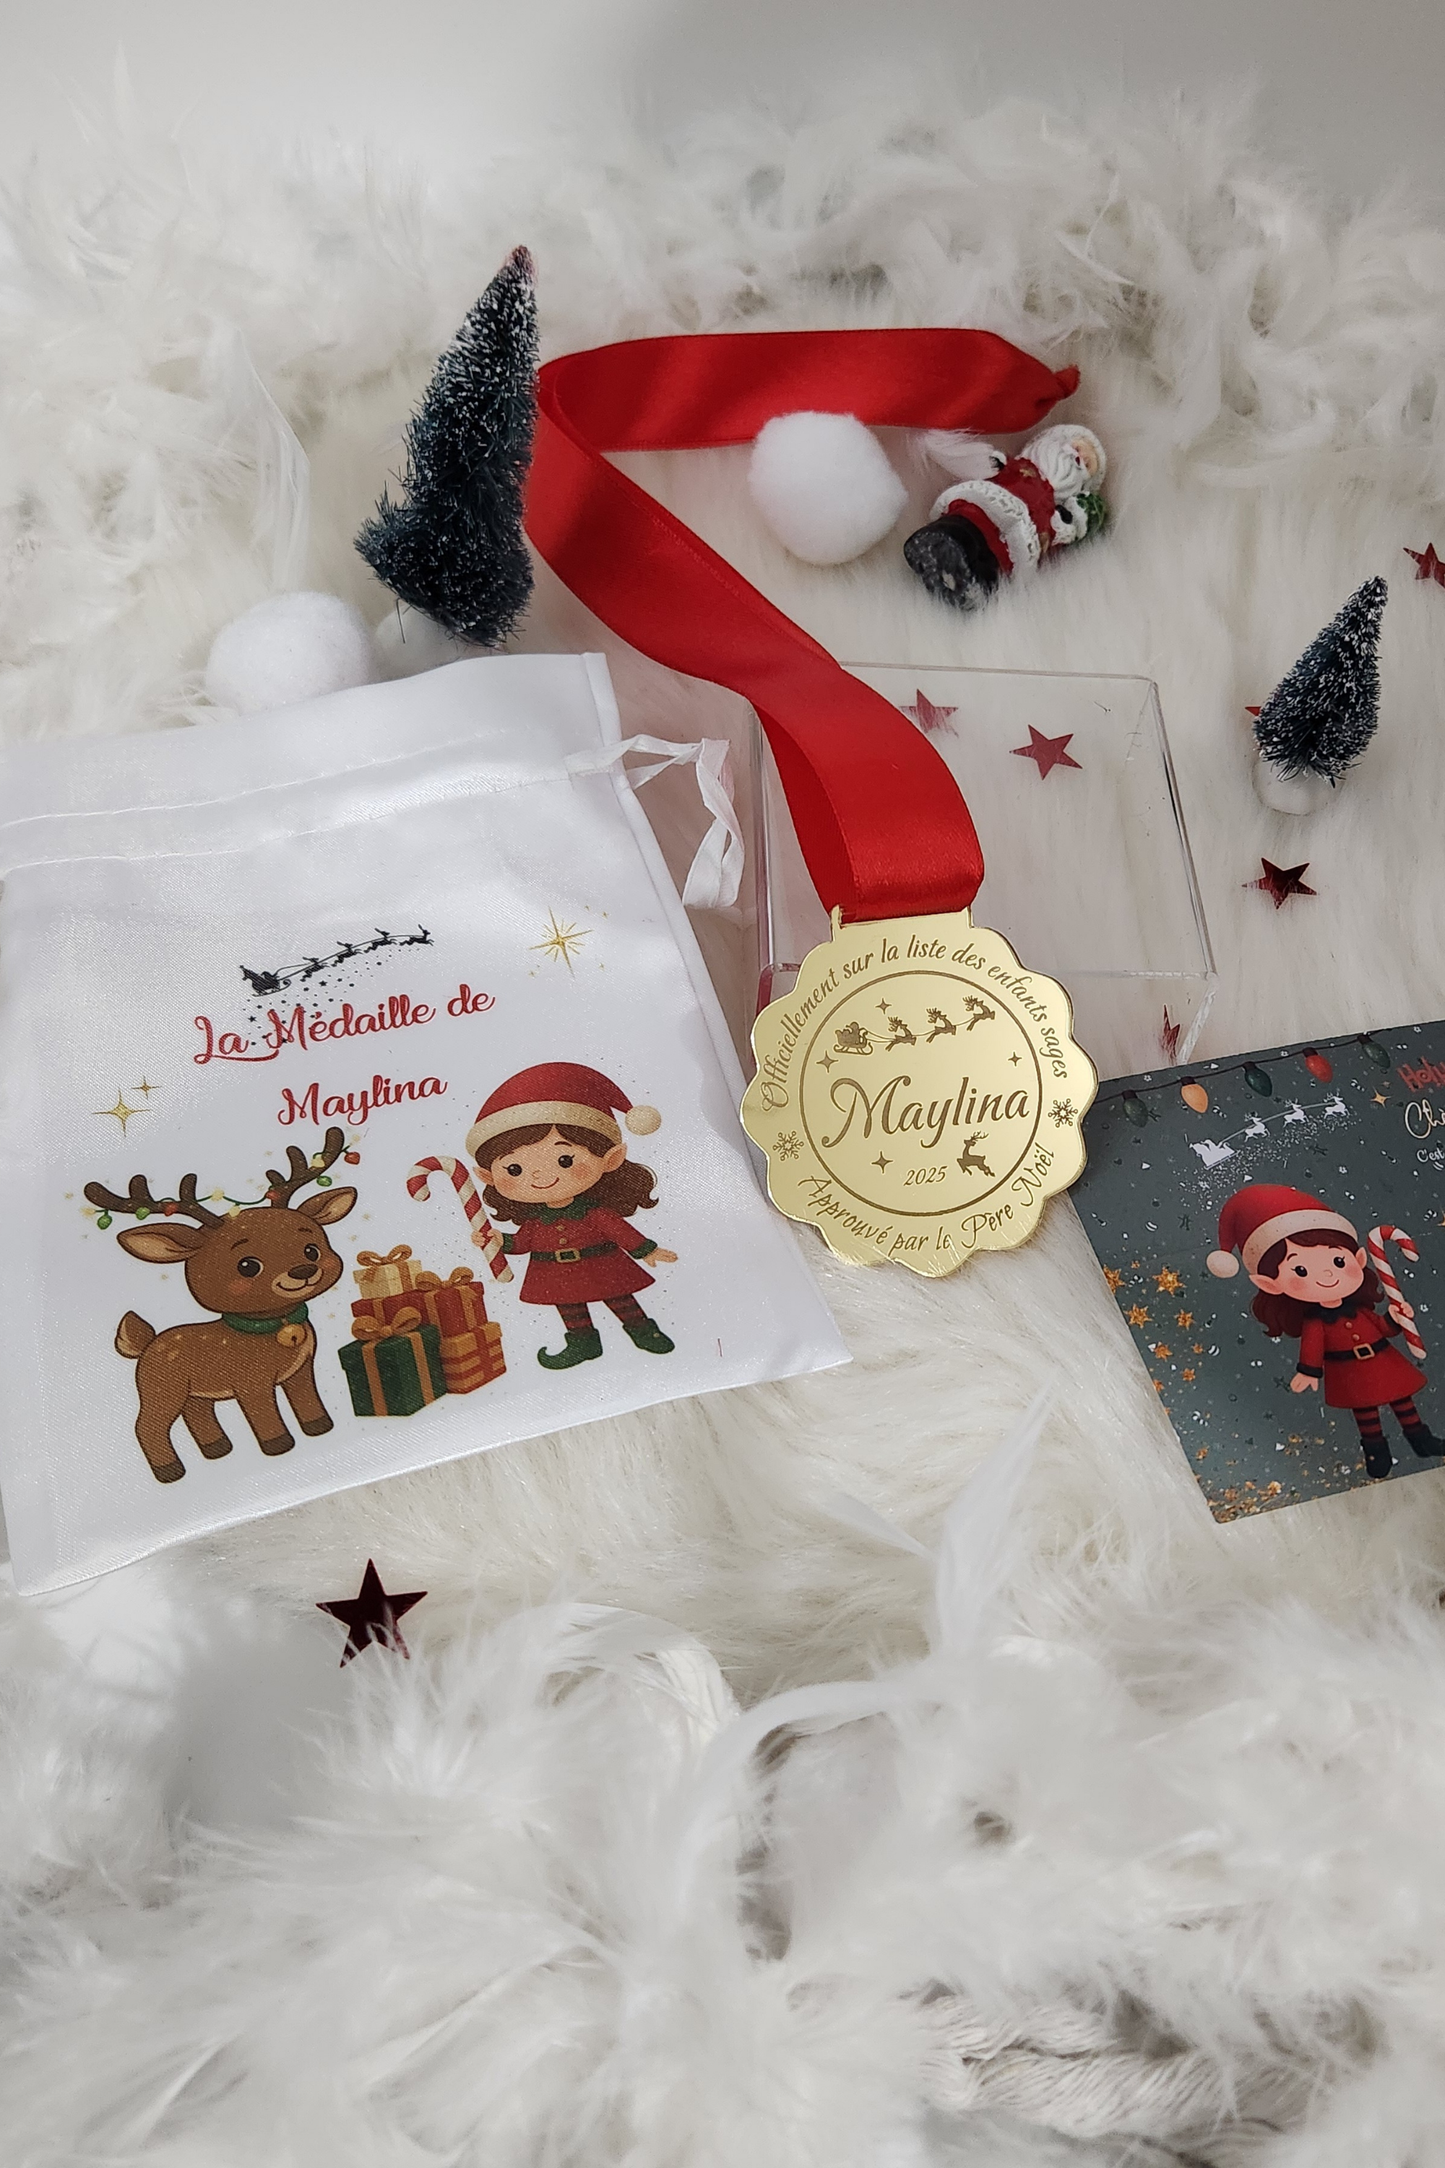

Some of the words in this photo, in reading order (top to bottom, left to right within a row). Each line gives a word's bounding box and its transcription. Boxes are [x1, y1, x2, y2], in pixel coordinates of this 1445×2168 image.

[194, 1015, 279, 1065] La
[266, 994, 436, 1051] Médaille
[446, 983, 496, 1018] de
[761, 967, 840, 1112] Officiellement
[843, 951, 874, 980] sur
[881, 938, 899, 963] la
[907, 934, 947, 959] liste
[951, 942, 986, 970] des
[987, 965, 1047, 1022] enfants
[1039, 1027, 1068, 1079] sages
[277, 1074, 448, 1126] Maylina
[821, 1075, 1030, 1148] Maylina
[798, 1175, 893, 1244] Approuvé
[888, 1233, 929, 1257] par
[935, 1226, 952, 1251] le
[960, 1203, 1014, 1249] Père
[1011, 1142, 1055, 1207] Noël
[903, 1165, 948, 1187] 2025
